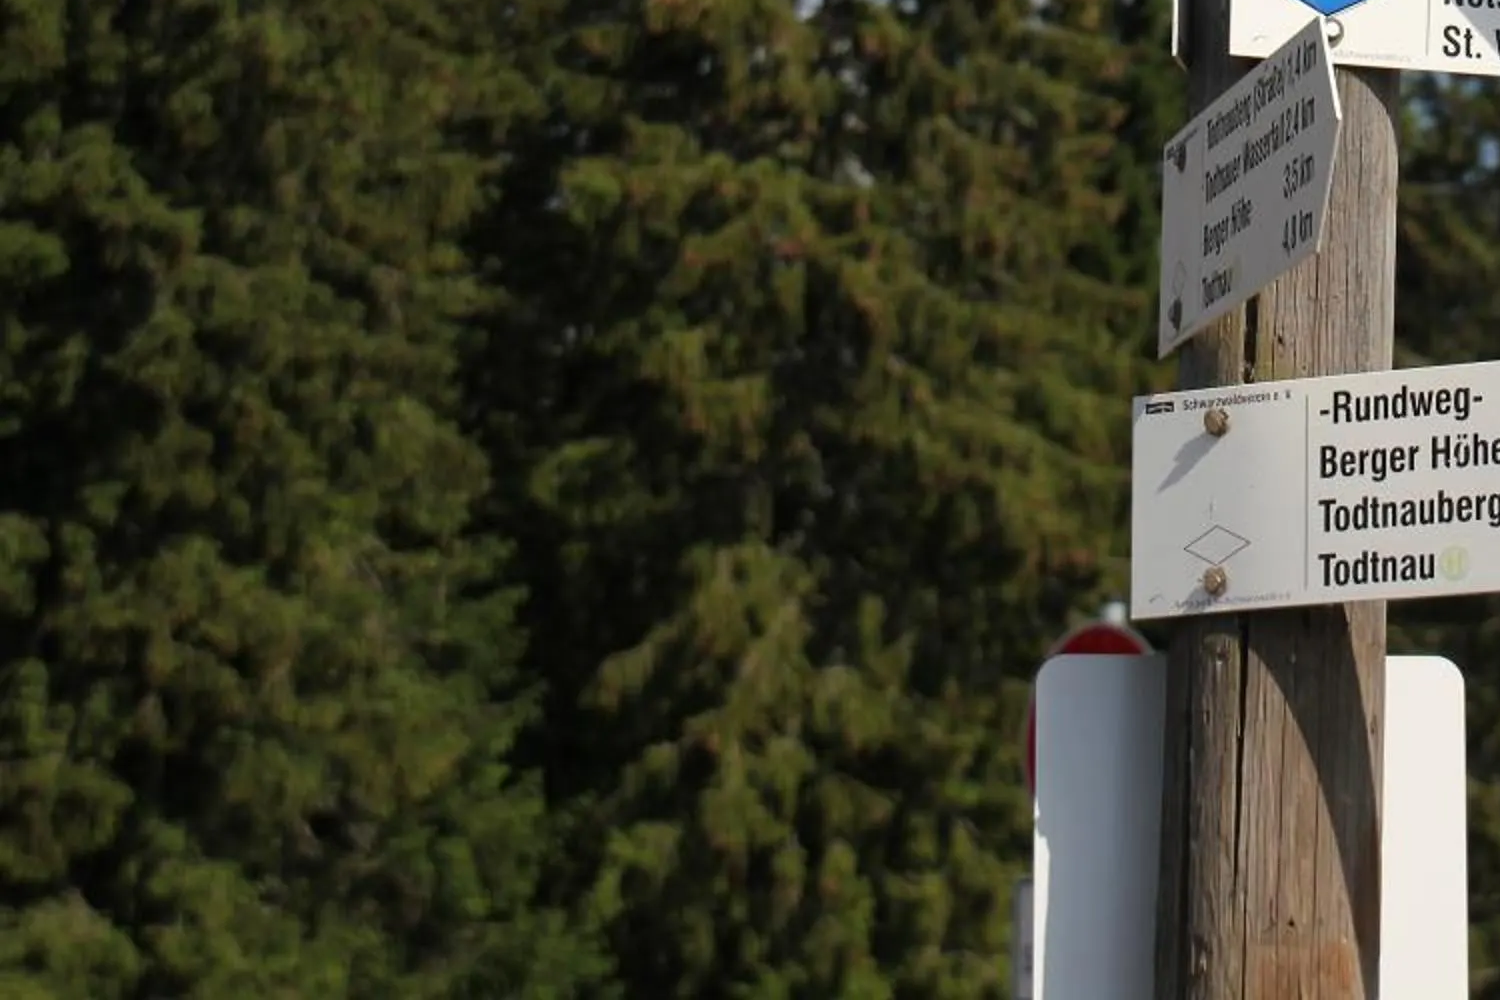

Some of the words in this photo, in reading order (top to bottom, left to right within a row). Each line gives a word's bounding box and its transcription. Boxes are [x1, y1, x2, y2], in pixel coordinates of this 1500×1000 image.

[1442, 24, 1484, 59] St.
[1302, 96, 1315, 131] km
[1300, 154, 1314, 187] km
[1299, 209, 1313, 242] km
[1319, 384, 1483, 425] -Rundweg-
[1319, 444, 1420, 483] Berger
[1317, 550, 1435, 587] Todtnau
